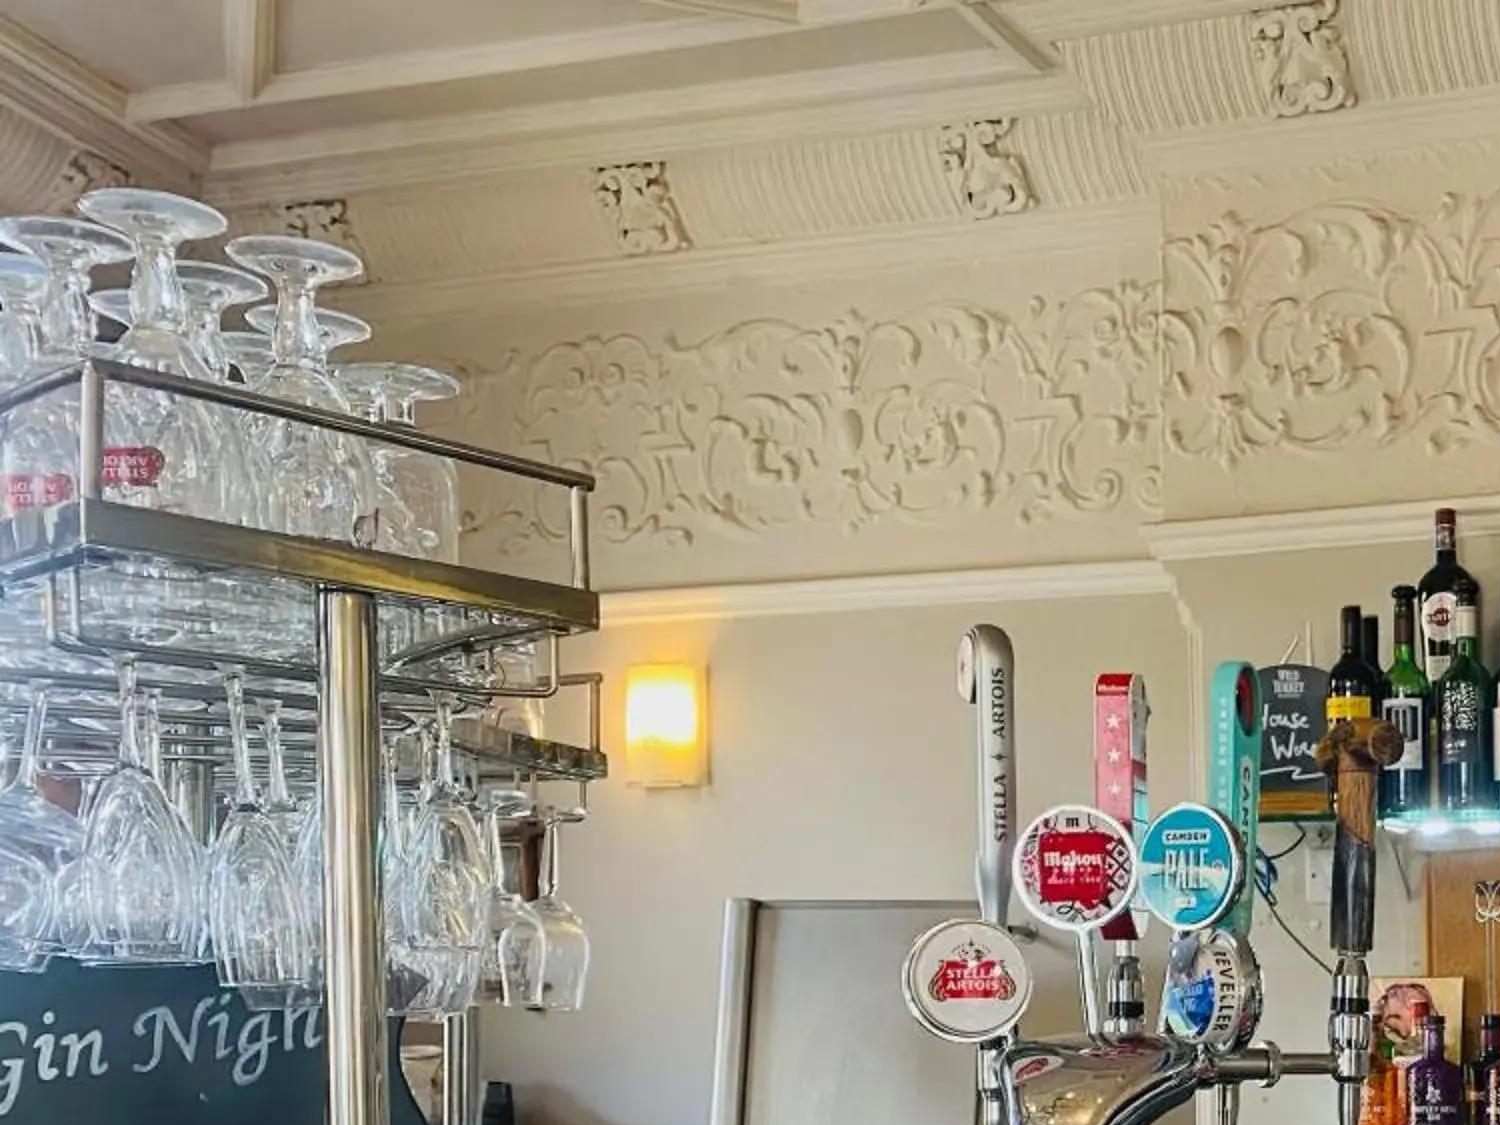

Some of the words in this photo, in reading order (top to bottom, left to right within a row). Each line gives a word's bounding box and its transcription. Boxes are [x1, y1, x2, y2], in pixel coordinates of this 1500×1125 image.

[990, 667, 1006, 739] ARTOIS
[992, 773, 1009, 843] STELLA
[1165, 832, 1208, 842] CAMDEN
[1164, 848, 1208, 890] PALE
[946, 979, 1000, 991] ARTOIS
